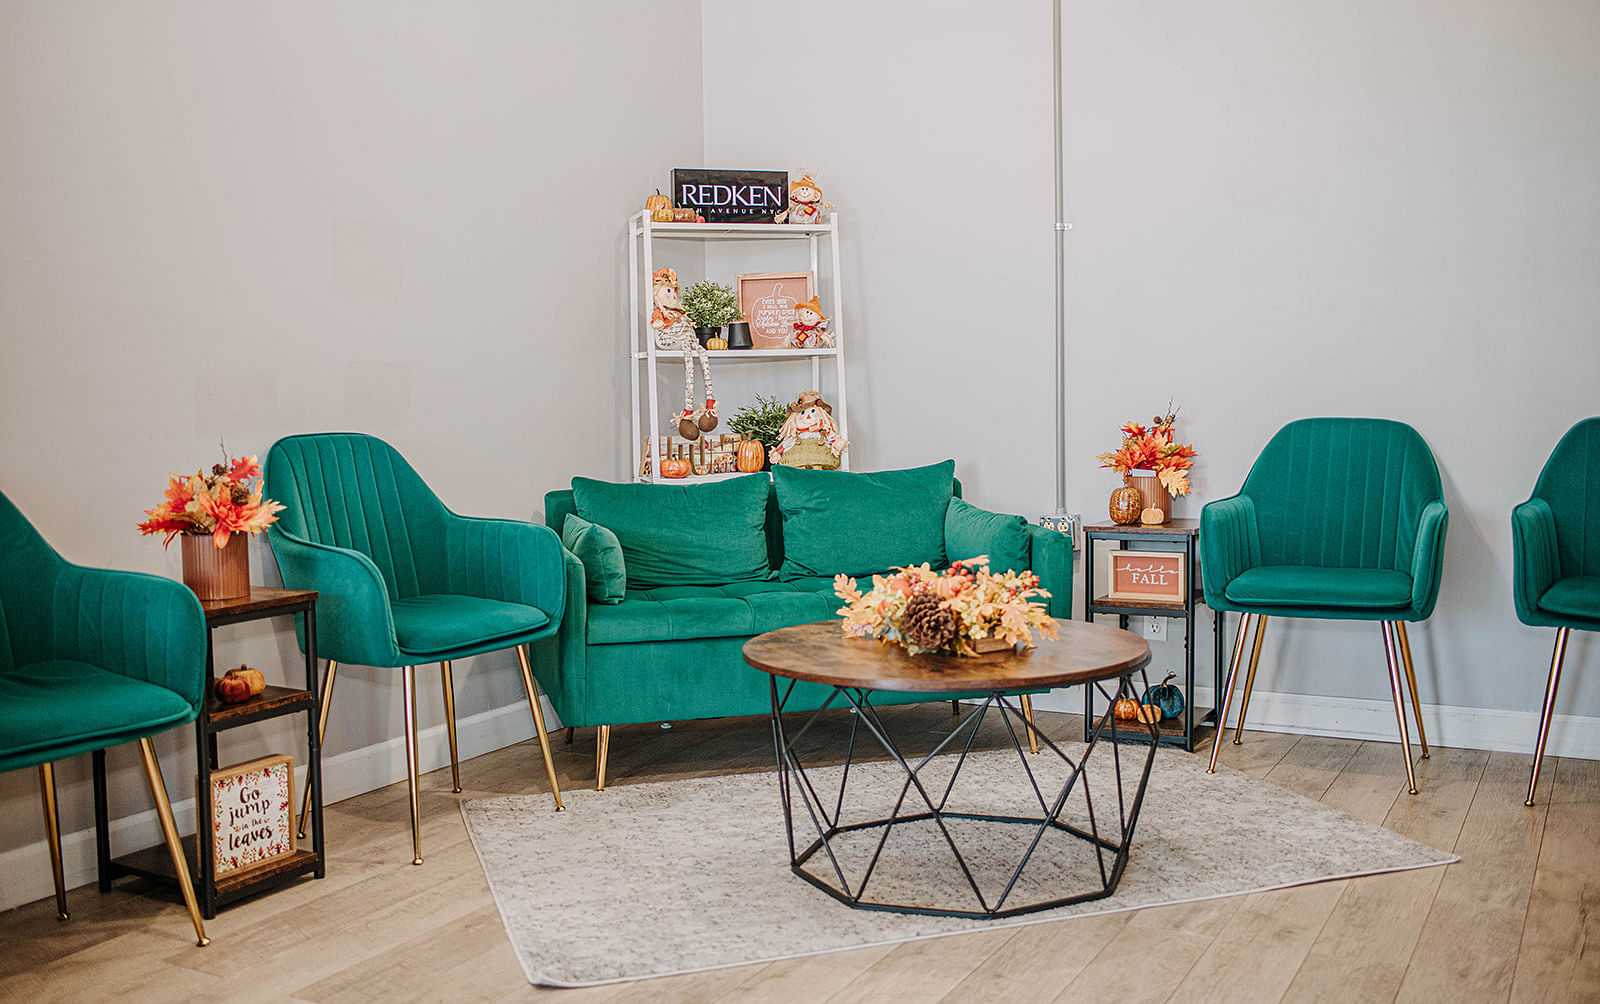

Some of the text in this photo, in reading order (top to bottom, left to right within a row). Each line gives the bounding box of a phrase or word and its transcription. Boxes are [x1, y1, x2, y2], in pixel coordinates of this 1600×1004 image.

[682, 184, 783, 207] REDKEN
[1132, 572, 1168, 585] FALL
[240, 786, 260, 804] Go
[229, 799, 270, 826] jump
[241, 822, 249, 831] in
[229, 826, 272, 850] leaves
